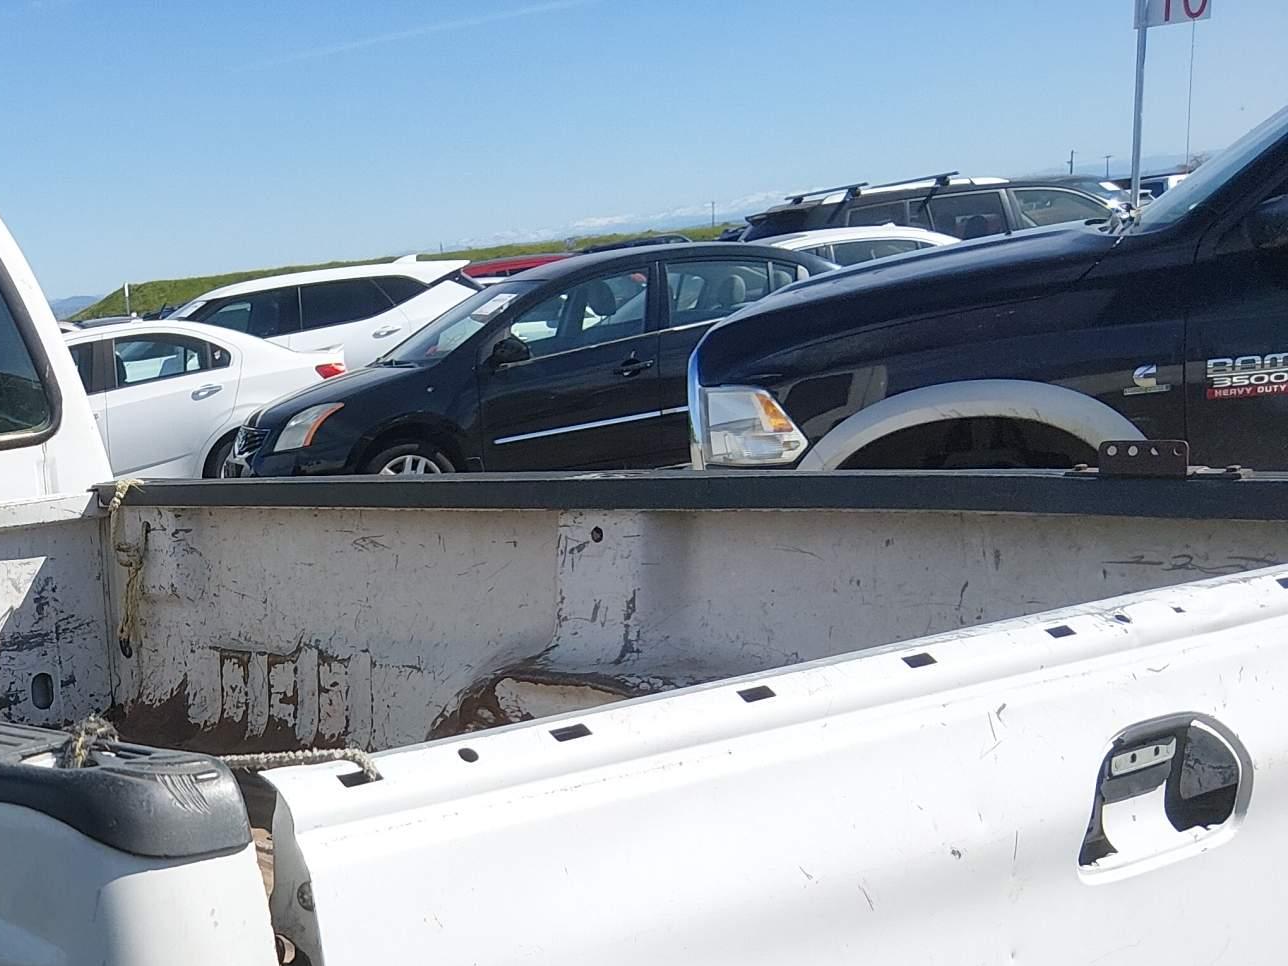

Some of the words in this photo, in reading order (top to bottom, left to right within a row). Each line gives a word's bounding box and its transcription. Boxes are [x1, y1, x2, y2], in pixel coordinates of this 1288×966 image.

[1207, 353, 1288, 374] RAM
[1213, 372, 1288, 388] 3500
[1214, 387, 1253, 397] HEAVY
[1257, 384, 1287, 393] DUTY
